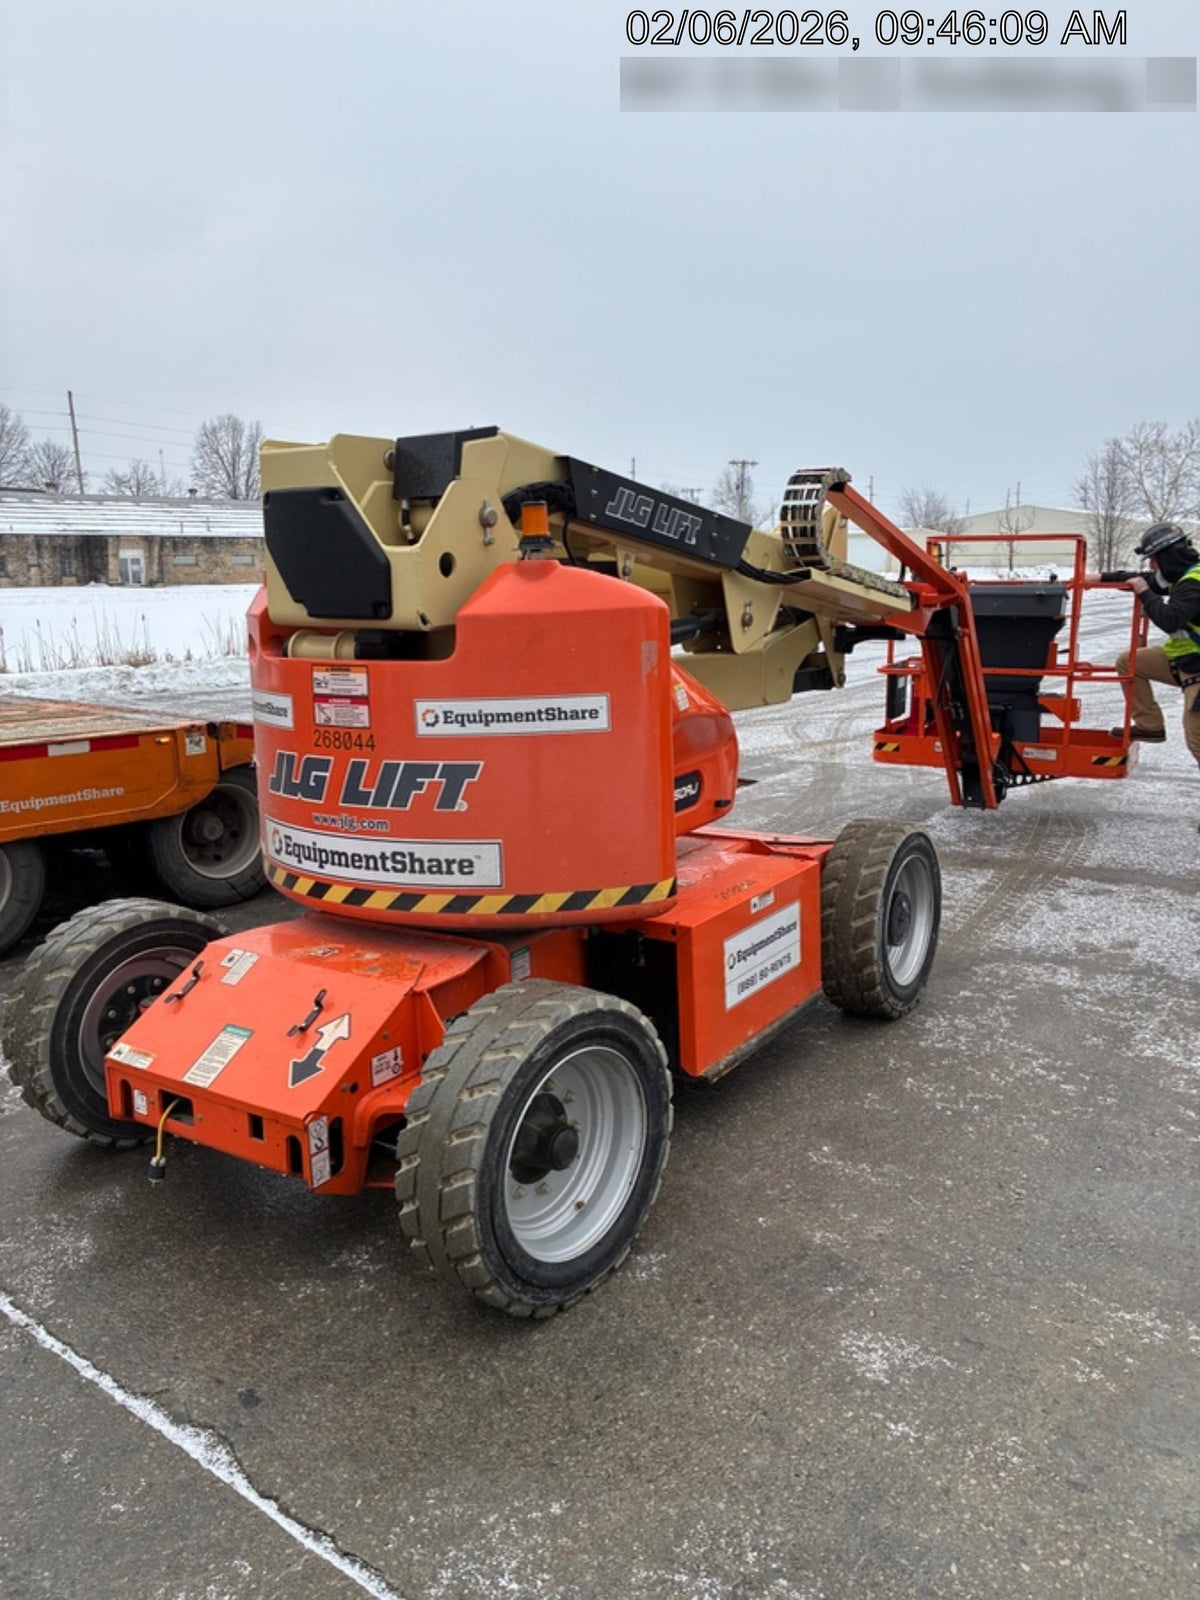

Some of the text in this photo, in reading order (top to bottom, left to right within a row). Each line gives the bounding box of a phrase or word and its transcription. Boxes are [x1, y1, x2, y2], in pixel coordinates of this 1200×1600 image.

[605, 487, 703, 545] JLG LIFT
[442, 707, 600, 728] EquipmentShare
[313, 728, 376, 752] 268044
[268, 750, 484, 812] JLG LIFT
[0, 786, 125, 814] EquipmentShare
[312, 812, 390, 831] www.jlg.com
[283, 834, 476, 876] EquipmentShare
[736, 921, 797, 962] EquipmentShare
